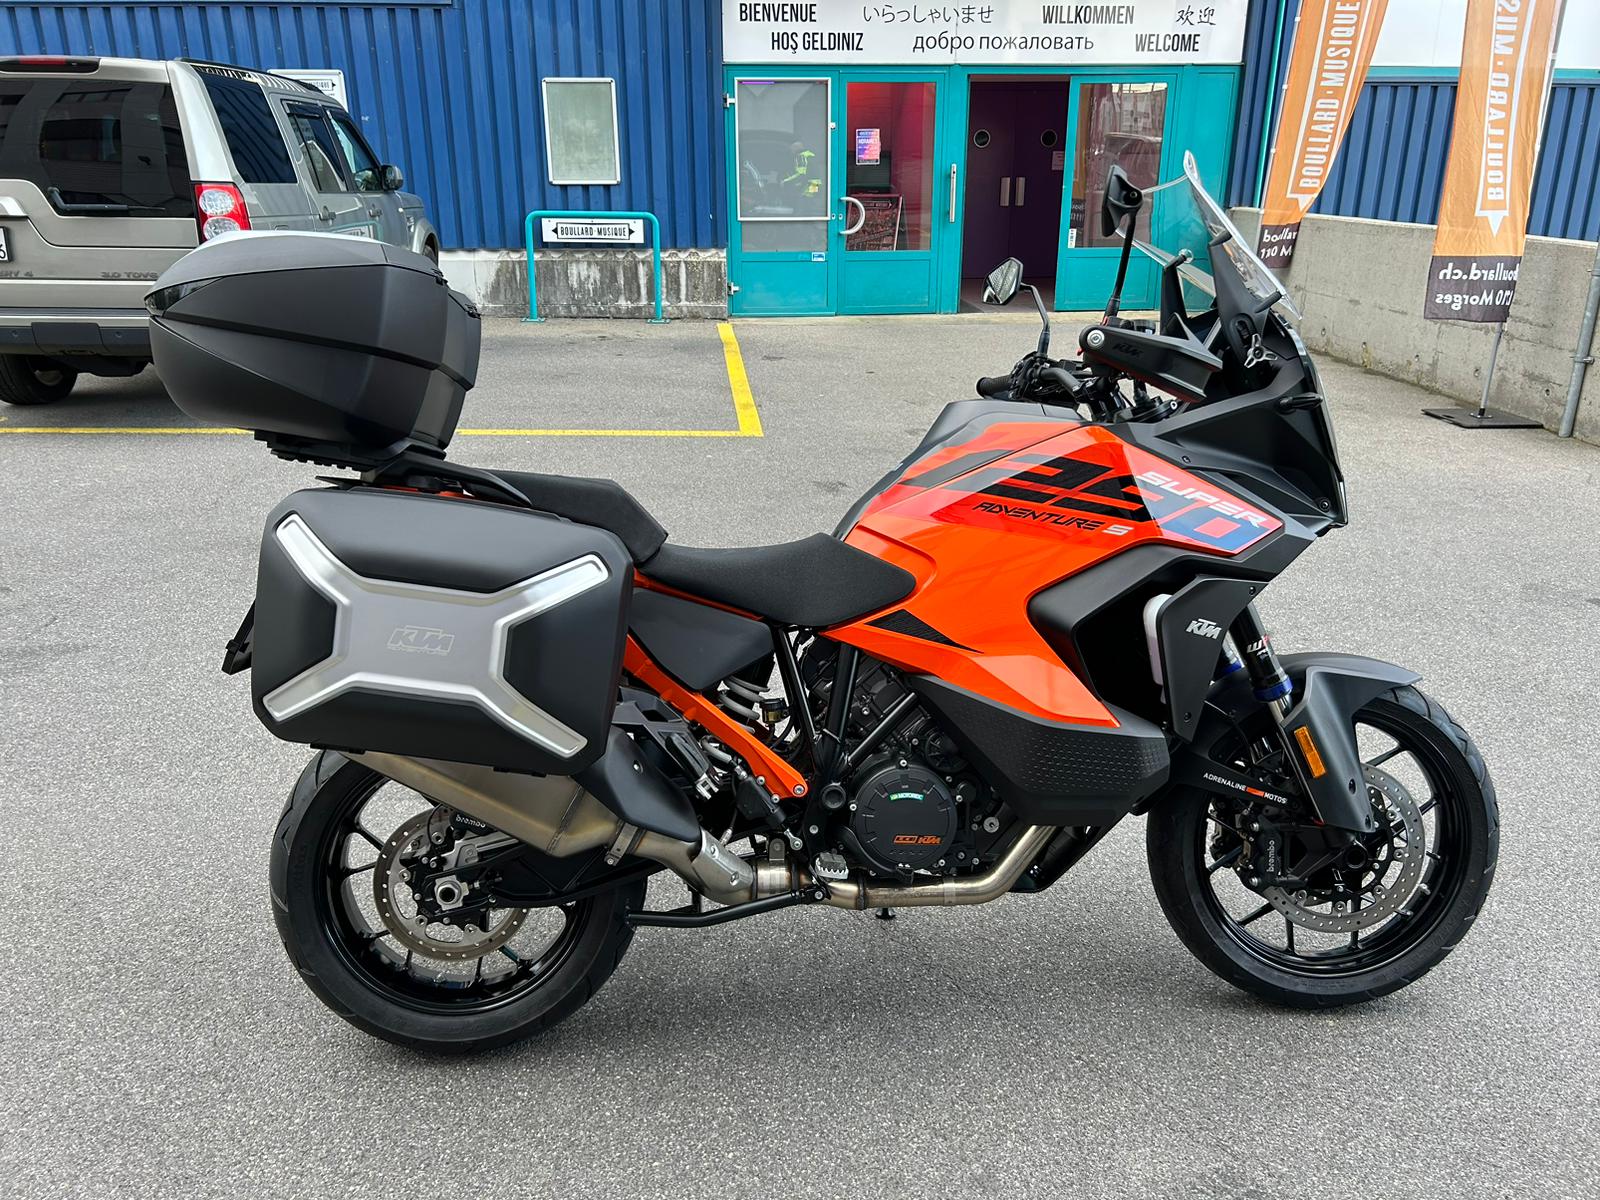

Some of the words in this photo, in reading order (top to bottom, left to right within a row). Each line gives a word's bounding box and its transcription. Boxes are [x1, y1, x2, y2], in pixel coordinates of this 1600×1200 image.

[739, 3, 817, 22] BIENVENUE
[863, 4, 994, 23] いらっしゃいませ
[1042, 5, 1135, 24] WILLKOMMEN
[1175, 5, 1217, 26] 欢迎
[771, 32, 798, 54] HOŞ
[802, 32, 864, 51] GELDINIZ
[912, 30, 975, 54] добро
[979, 34, 1094, 51] пожаловать
[1135, 33, 1201, 52] WELCOME
[1299, 99, 1340, 188] BOULLARD
[1320, 2, 1361, 87] MUSIQUE
[560, 226, 594, 236] BOULLARD
[597, 227, 627, 237] MUSIQUE
[1135, 471, 1269, 528] SUPER
[972, 501, 1105, 532] ADVENTURE
[1102, 523, 1134, 537] S
[387, 624, 455, 655] KTM
[1185, 618, 1222, 639] KTM
[1203, 772, 1247, 792] ADRENALINE
[1263, 792, 1288, 805] MOTOS
[1266, 840, 1275, 873] brembo
